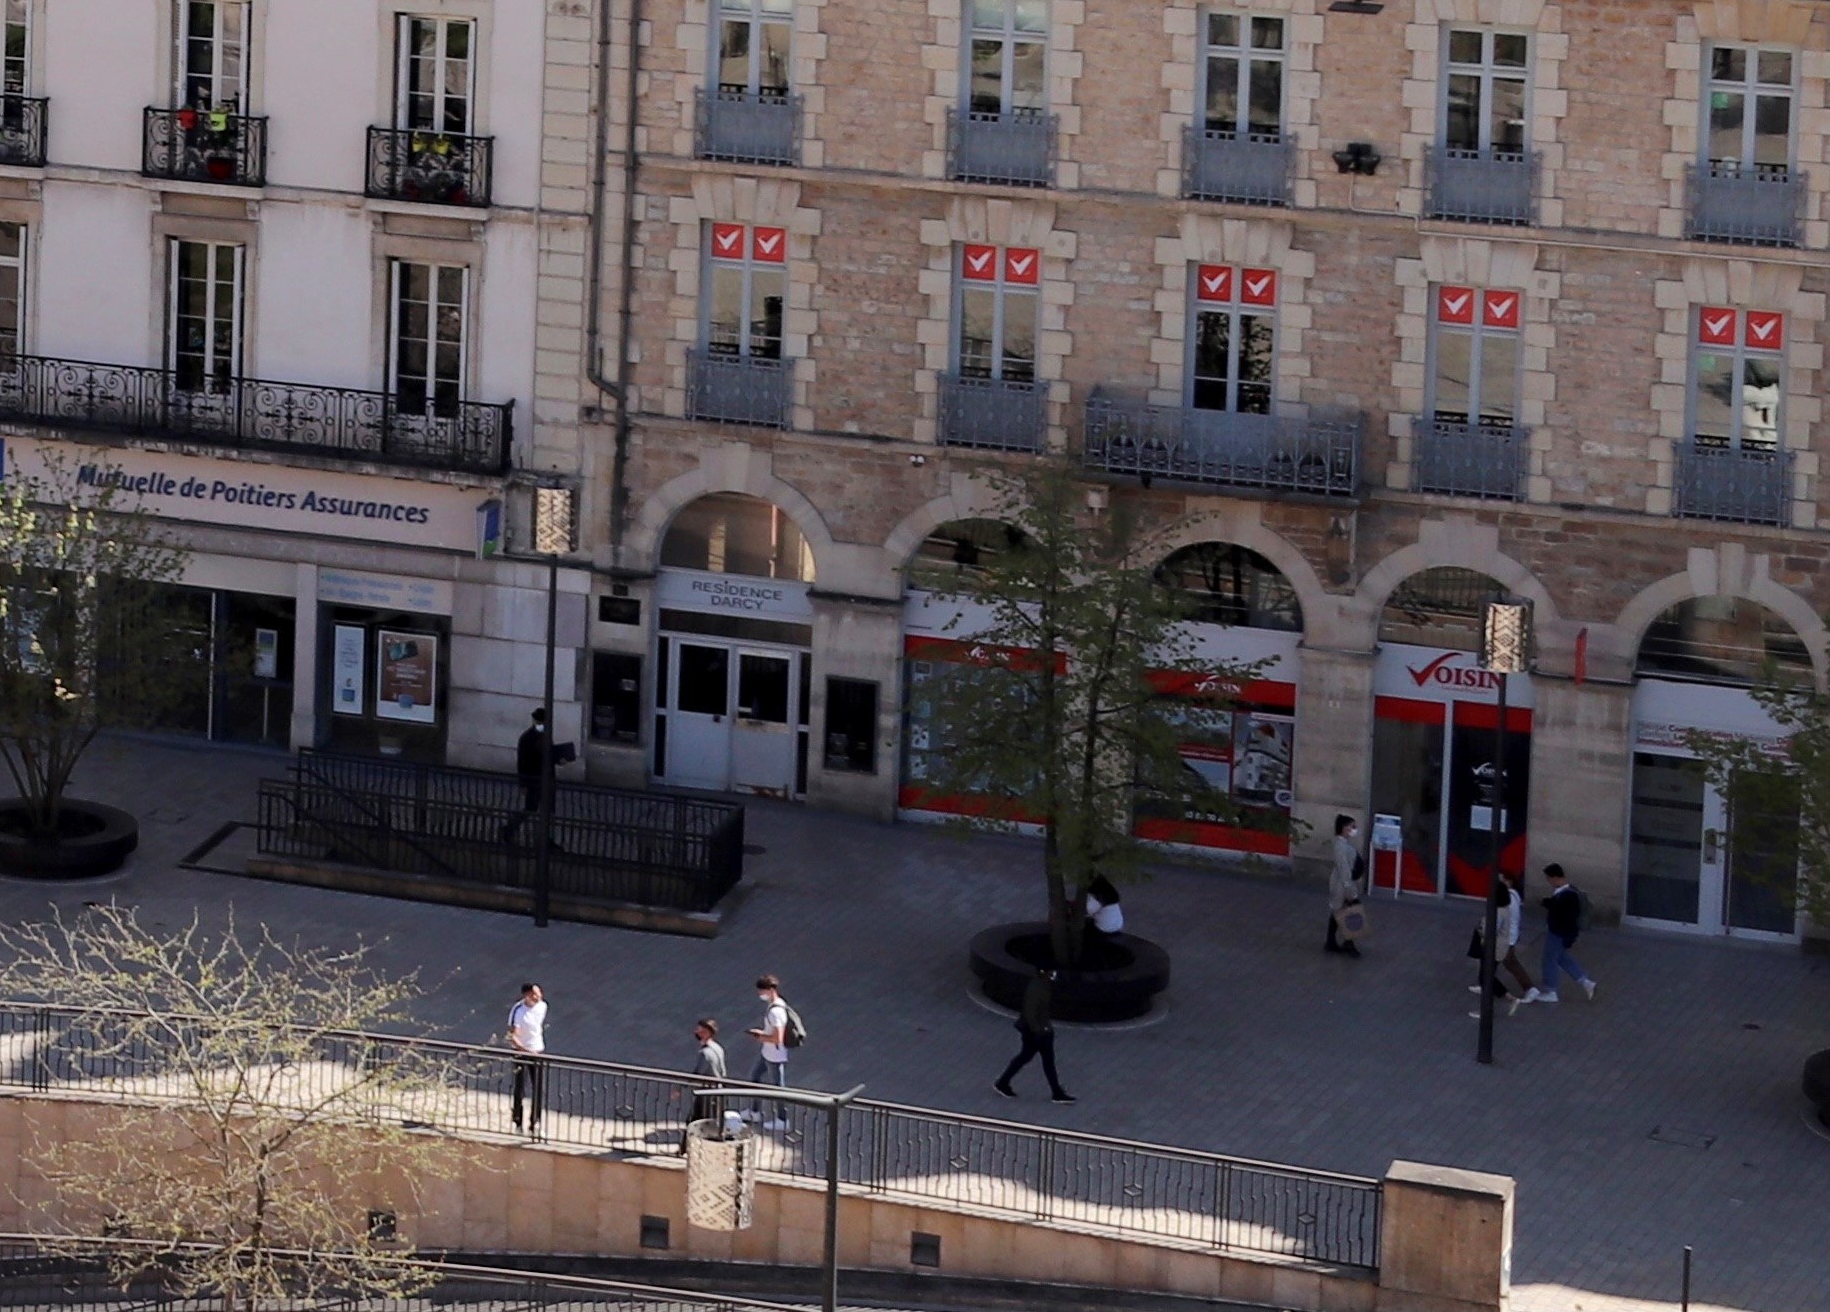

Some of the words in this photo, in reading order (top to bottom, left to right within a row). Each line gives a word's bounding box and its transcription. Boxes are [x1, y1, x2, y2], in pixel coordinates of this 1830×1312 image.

[180, 477, 206, 499] de
[210, 480, 296, 510] Poitiers
[300, 490, 430, 524] Assurances
[711, 595, 764, 610] DARCY
